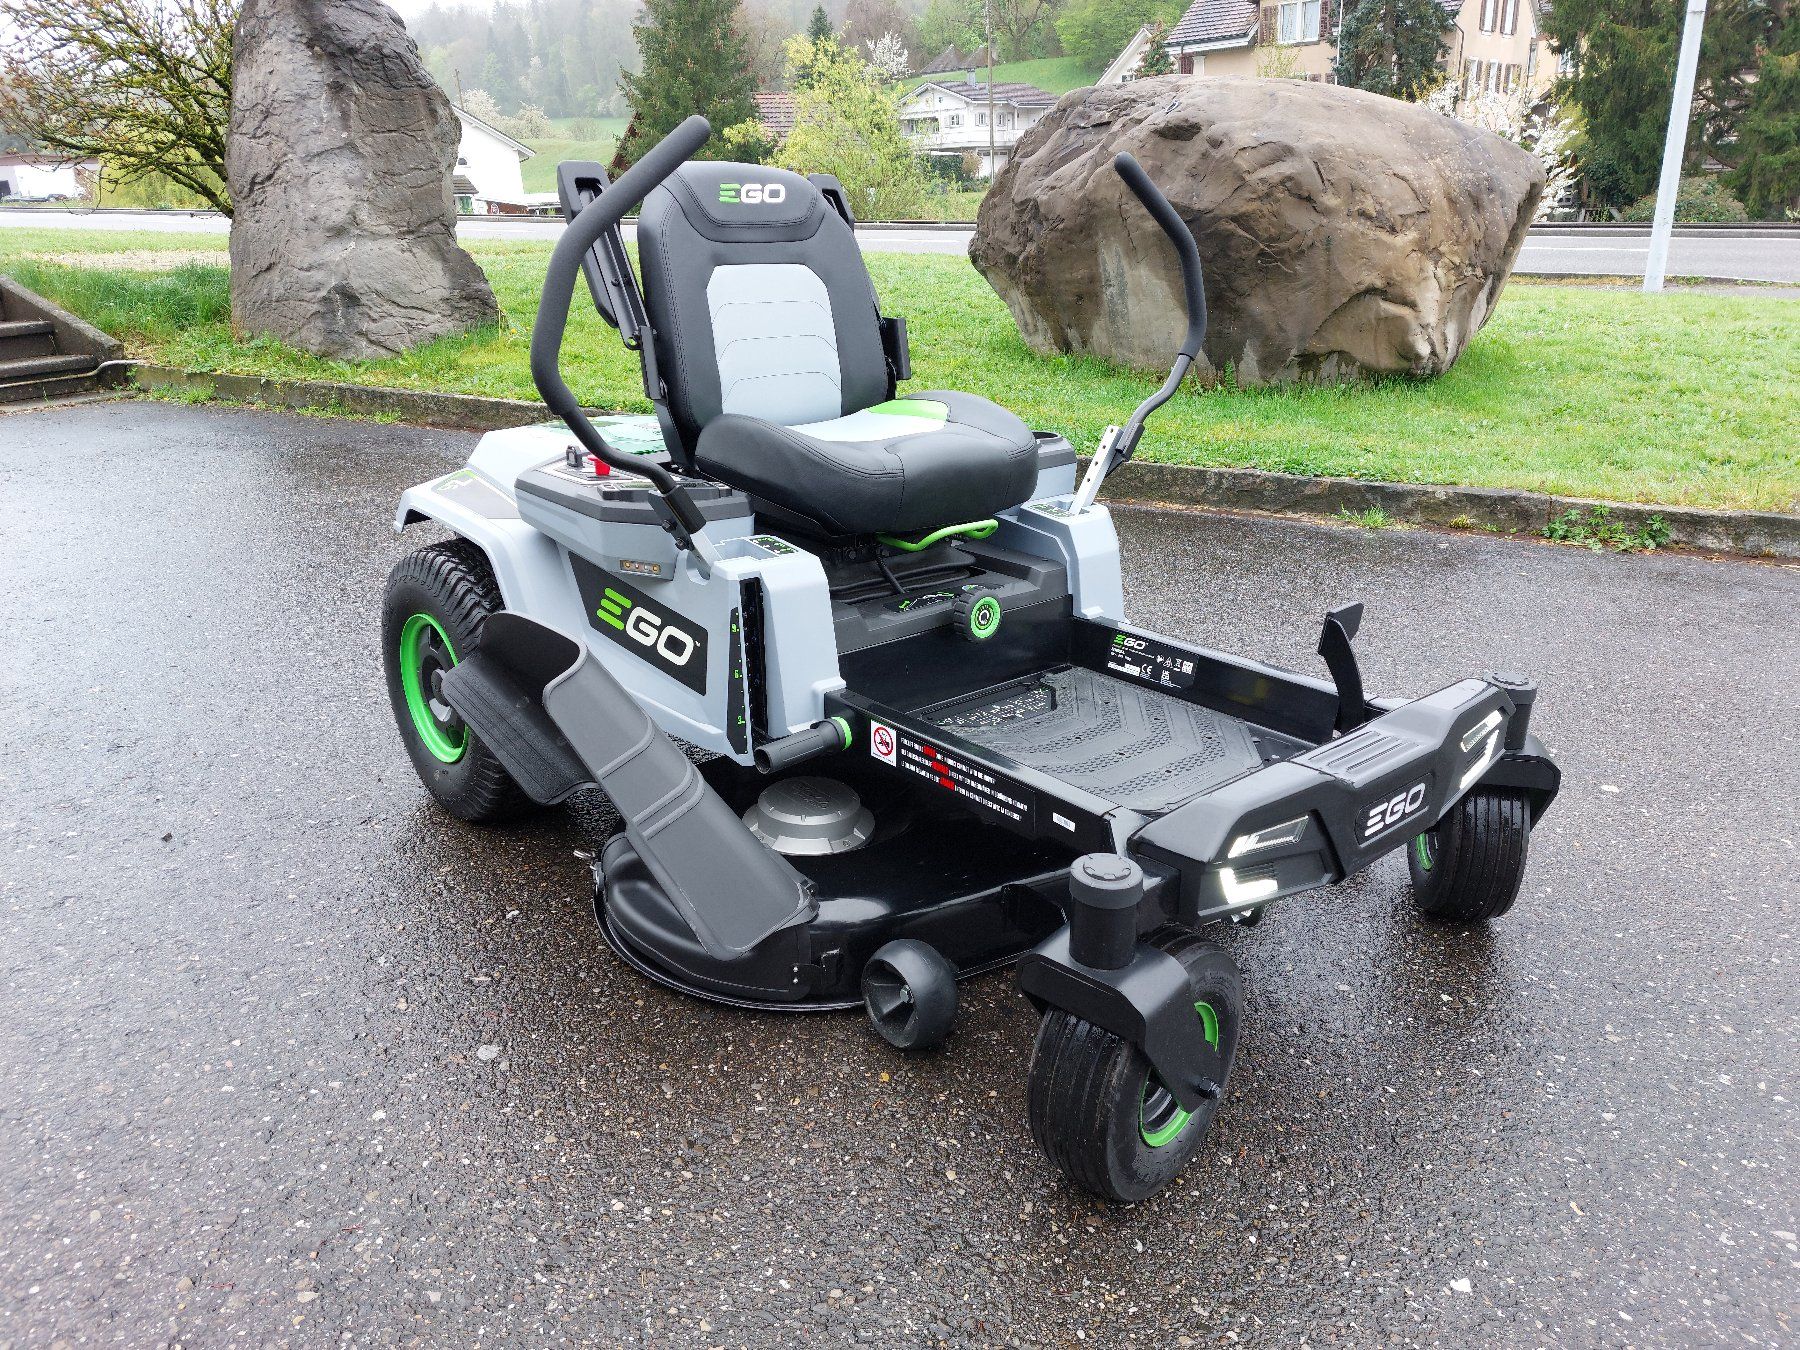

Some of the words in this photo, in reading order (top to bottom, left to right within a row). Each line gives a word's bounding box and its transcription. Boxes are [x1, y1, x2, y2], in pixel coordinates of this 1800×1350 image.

[719, 183, 786, 204] EGO
[596, 587, 694, 666] EGO
[1113, 634, 1146, 650] EGO
[1364, 782, 1426, 837] EGO
